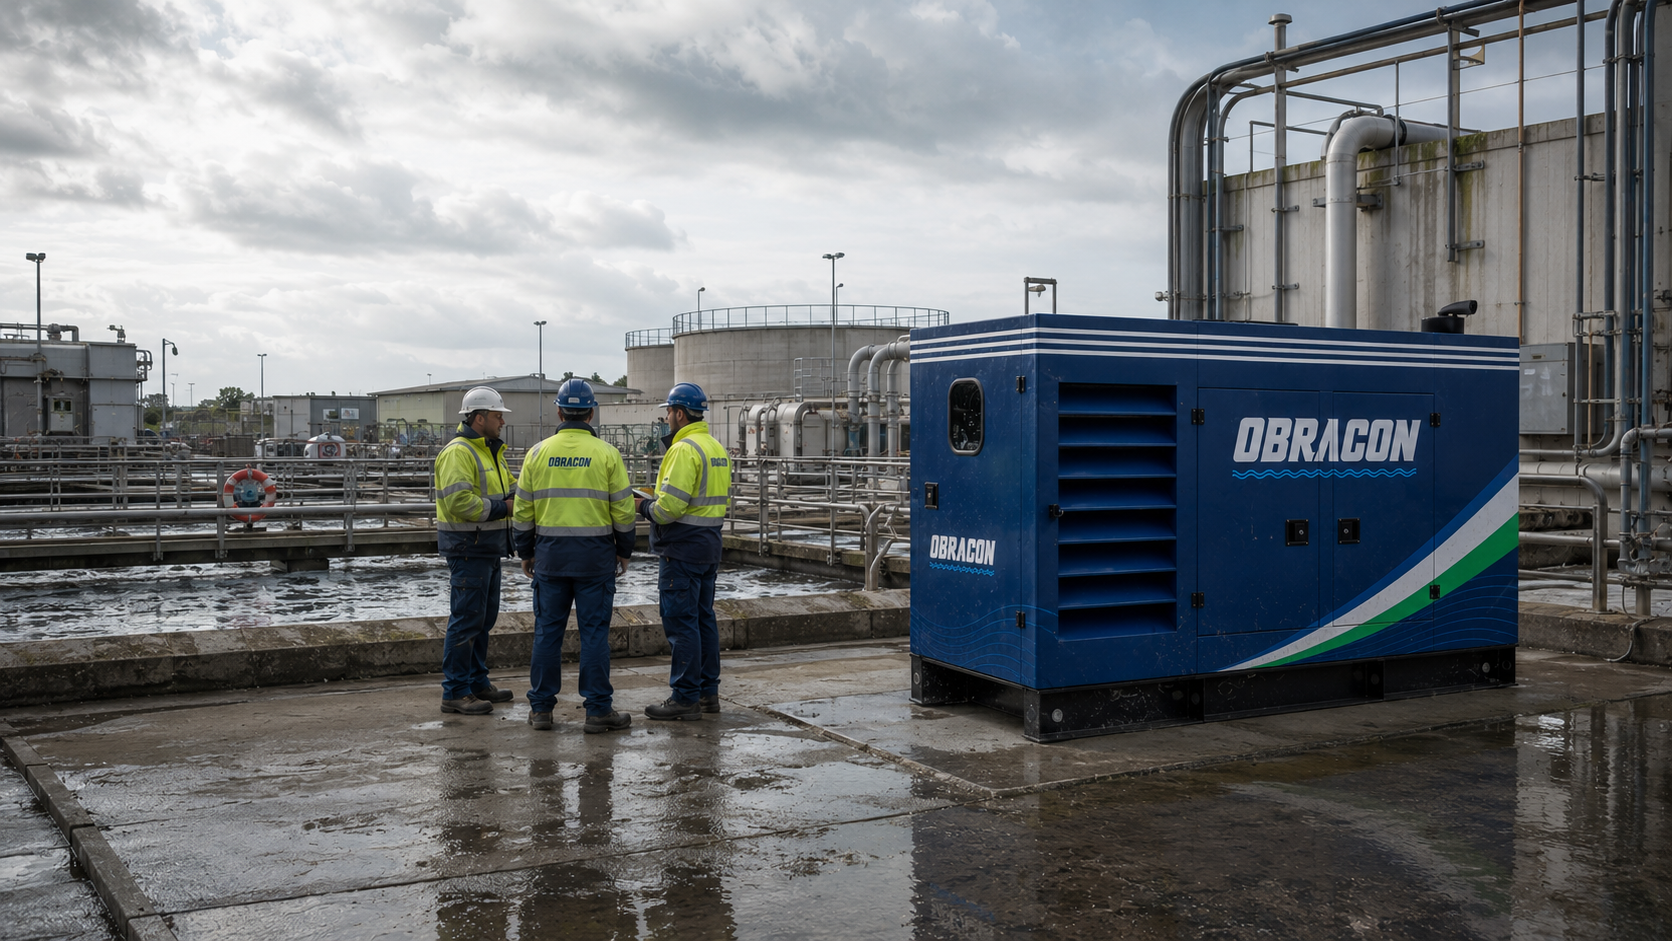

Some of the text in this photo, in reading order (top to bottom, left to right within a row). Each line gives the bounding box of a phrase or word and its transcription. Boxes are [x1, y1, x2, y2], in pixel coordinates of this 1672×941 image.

[1233, 417, 1421, 463] OBRACON
[548, 456, 592, 467] OBRACON
[929, 534, 996, 566] OBRACON
